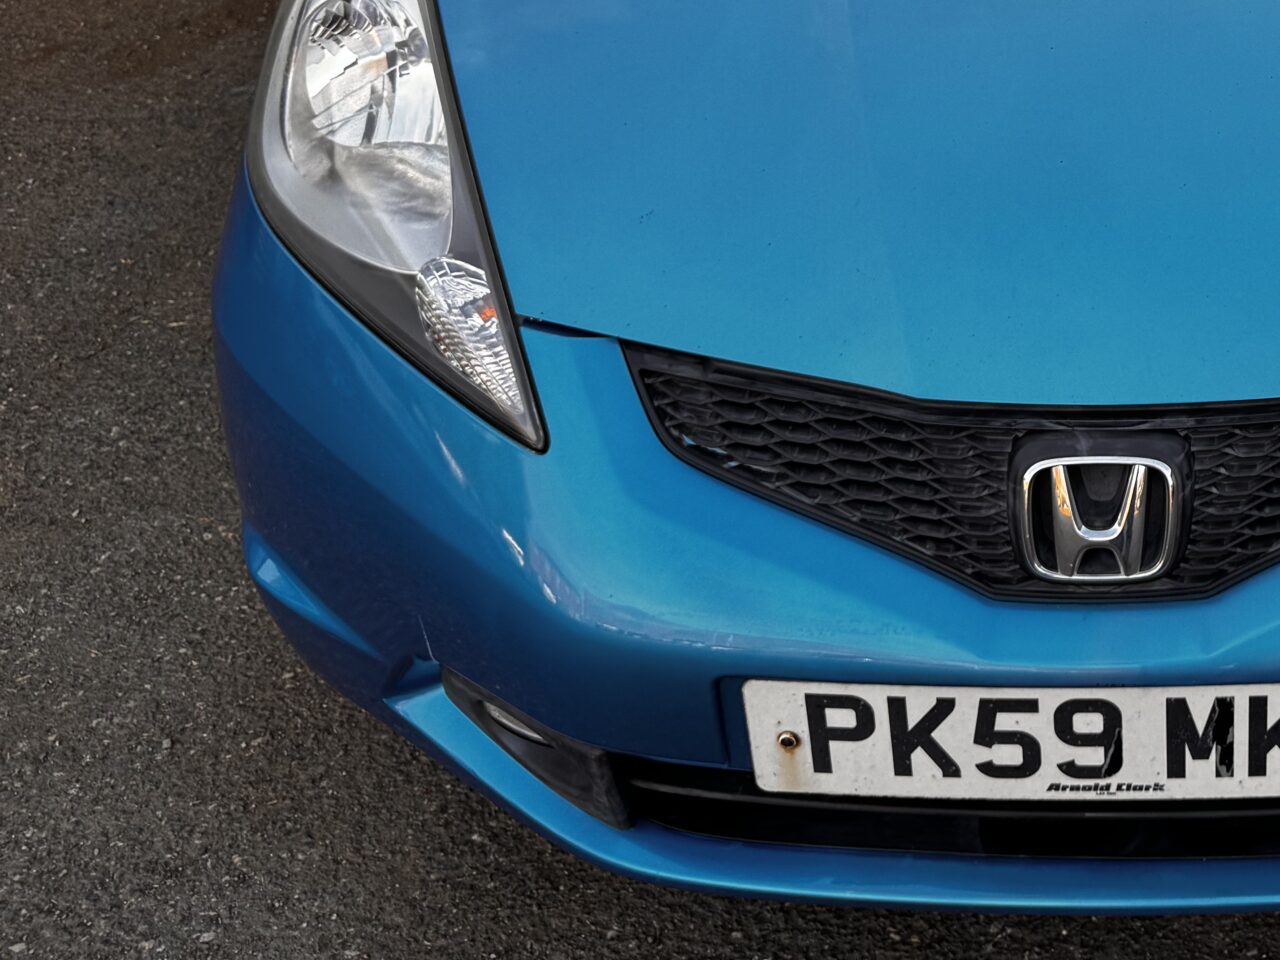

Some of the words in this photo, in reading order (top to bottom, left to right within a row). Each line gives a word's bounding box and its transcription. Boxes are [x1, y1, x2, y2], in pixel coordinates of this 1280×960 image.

[804, 692, 1125, 779] PK59
[1046, 782, 1112, 792] Arnold
[1116, 782, 1166, 792] Clark
